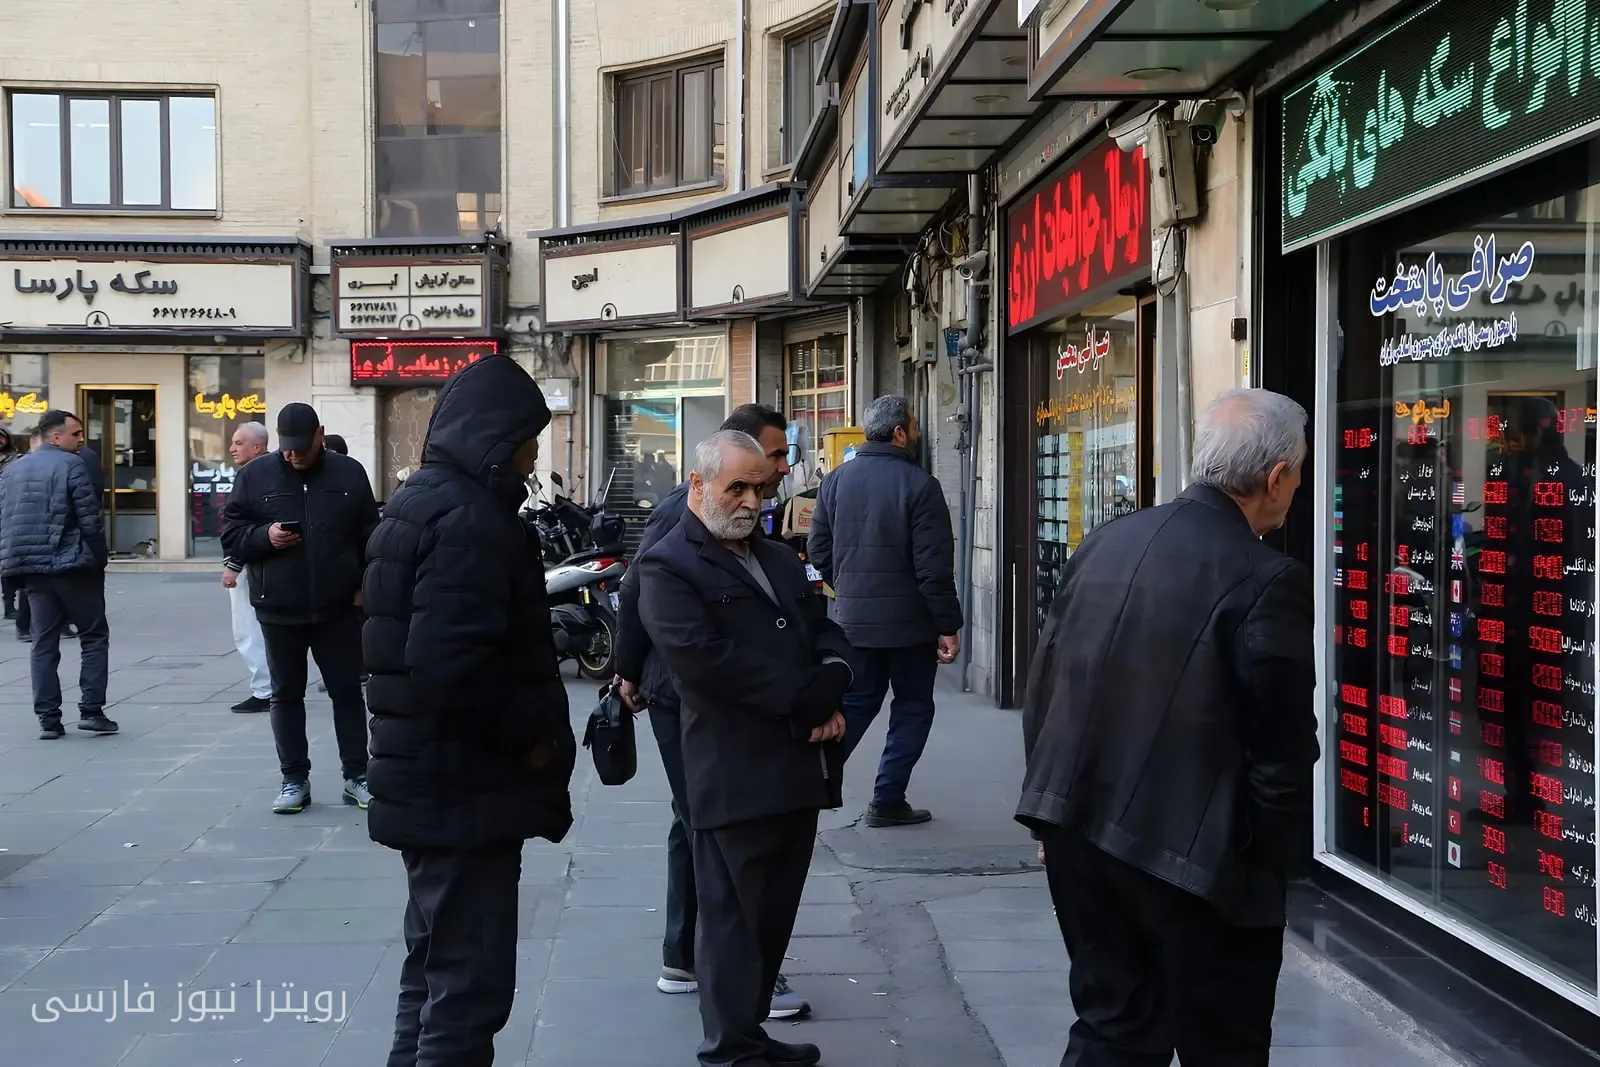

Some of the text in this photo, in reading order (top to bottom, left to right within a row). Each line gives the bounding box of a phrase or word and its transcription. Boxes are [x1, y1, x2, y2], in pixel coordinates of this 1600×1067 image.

[1413, 32, 1475, 128] سکه
[14, 269, 178, 305] سکه پارسا
[1370, 233, 1535, 318] صرافی پایتخت
[16, 392, 48, 414] سکه
[194, 392, 266, 419] سکه پارسا
[1568, 486, 1588, 506] آمریکا
